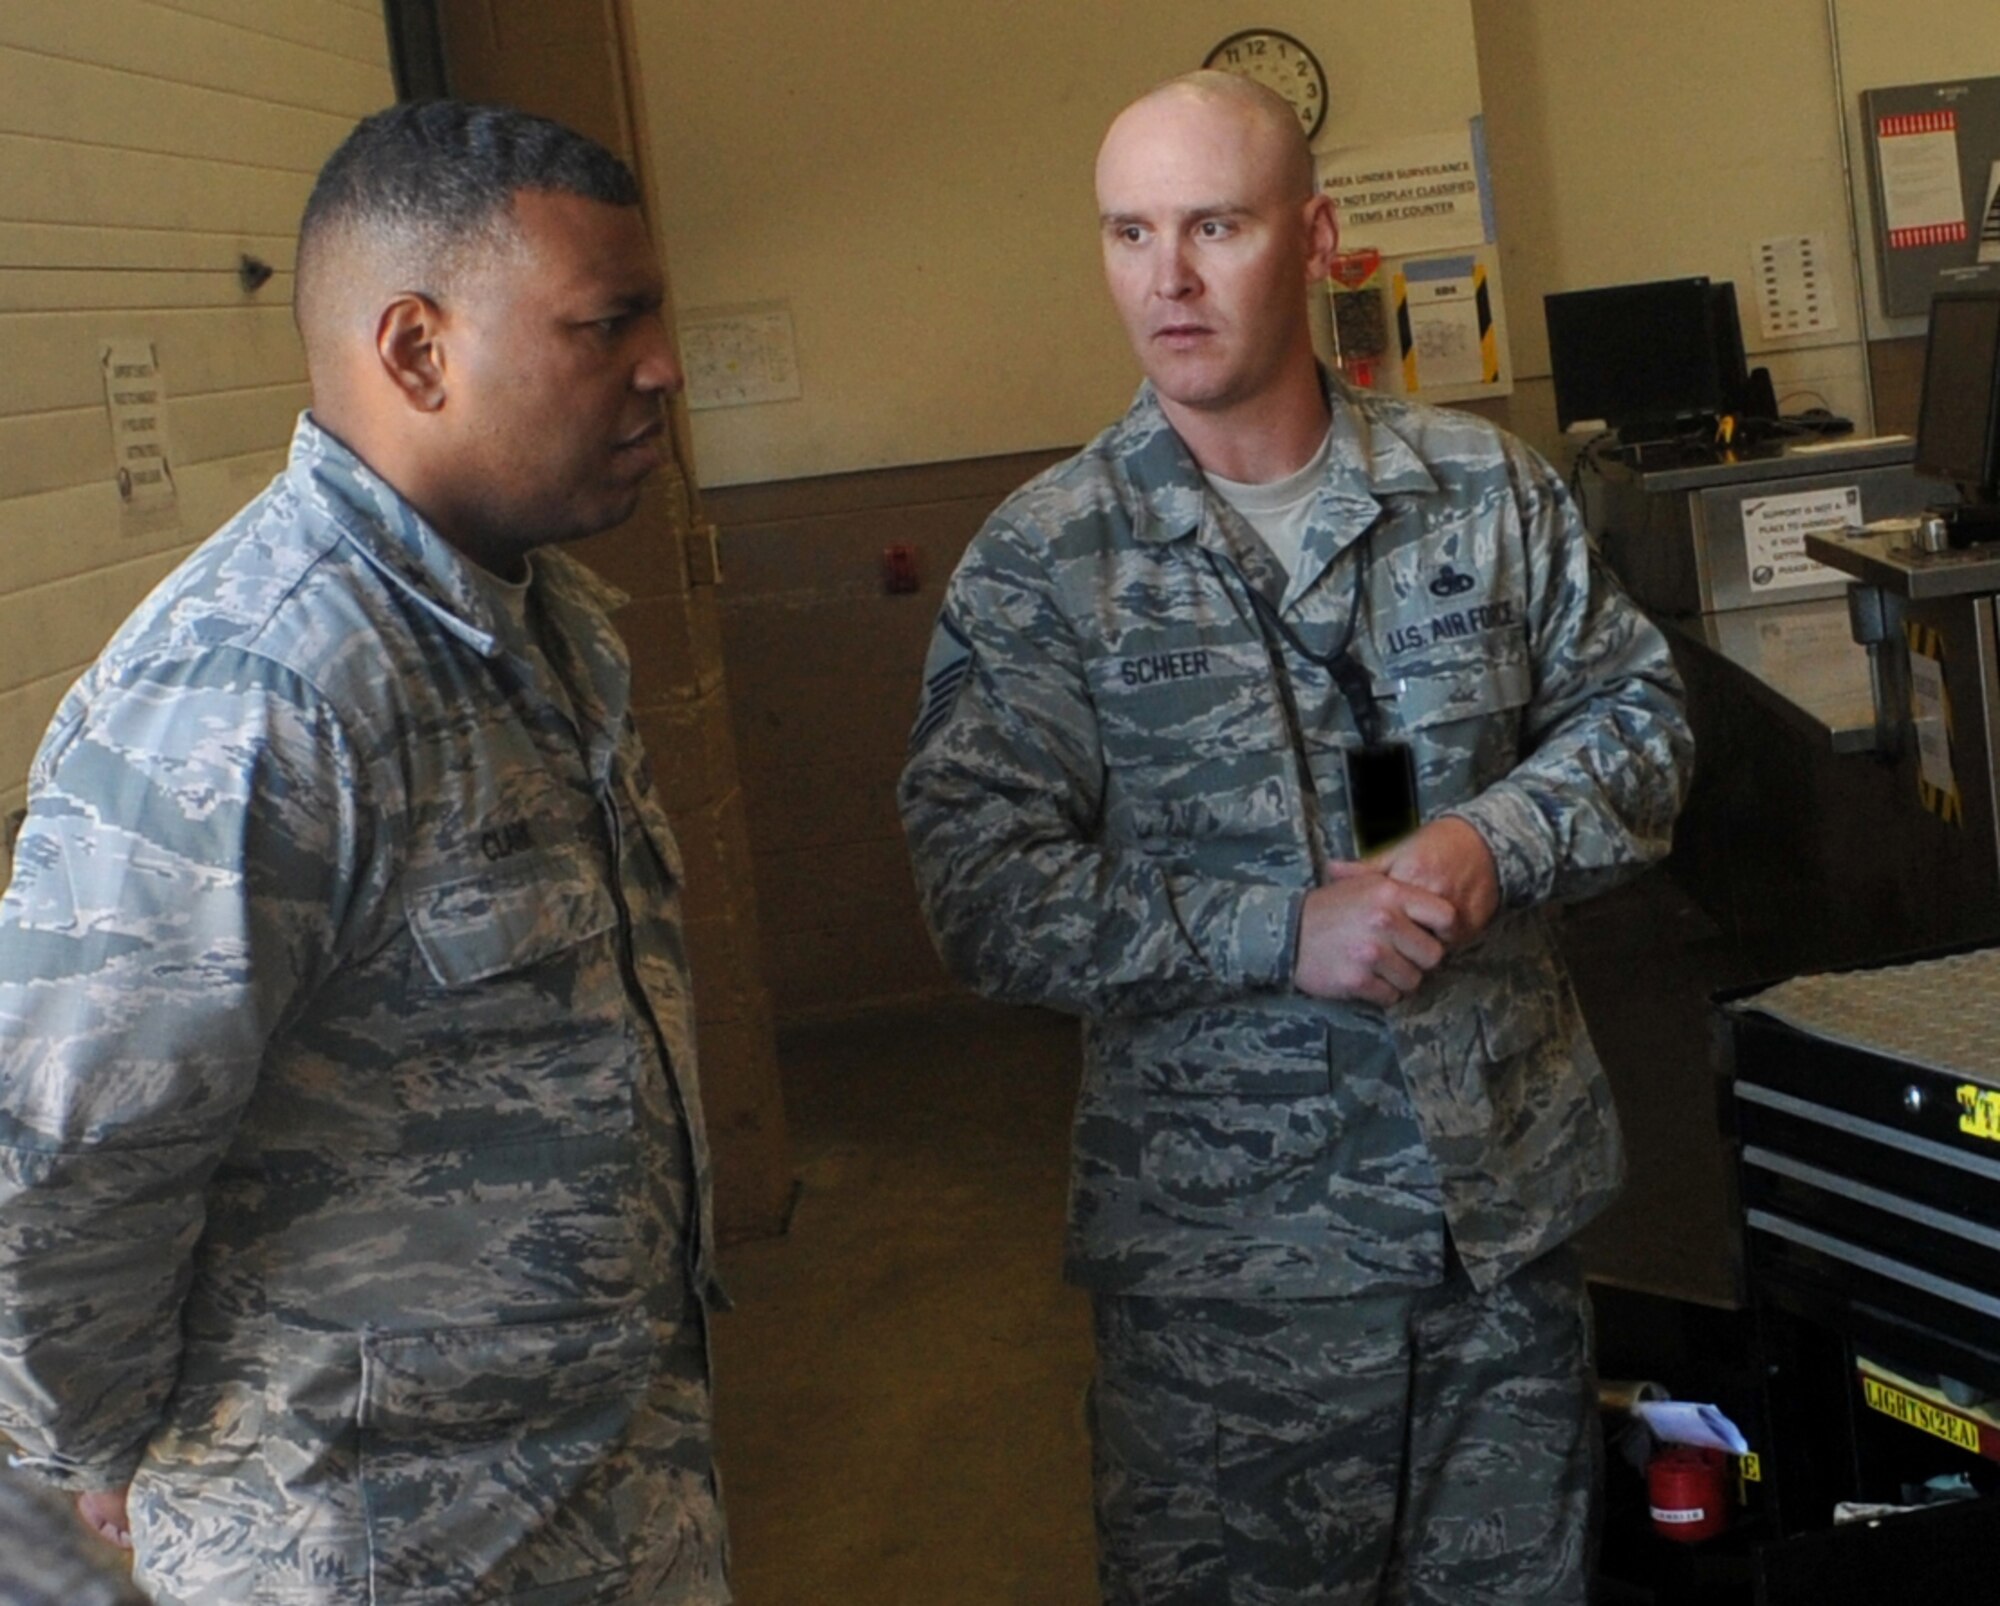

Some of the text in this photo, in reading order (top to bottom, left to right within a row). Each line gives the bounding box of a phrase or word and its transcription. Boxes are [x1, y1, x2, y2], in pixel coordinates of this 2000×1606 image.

[1225, 48, 1240, 64] 11
[1246, 40, 1266, 56] 12
[1278, 43, 1287, 59] 1
[1296, 60, 1308, 77] 2
[1306, 82, 1318, 98] 3
[1301, 107, 1312, 122] 4
[1324, 175, 1353, 188] AREA
[1356, 170, 1394, 184] UNDER
[1344, 193, 1367, 205] NOT
[1370, 188, 1414, 202] DISPLAY
[1416, 180, 1475, 197] CLASSIFIED
[1351, 201, 1455, 224] ITEMS AT COUNTER
[1387, 625, 1428, 654] U.S.
[1432, 612, 1468, 641] AIR
[1121, 650, 1210, 686] SCHEER
[1866, 1381, 1977, 1448] LIGHTS(2EA)
